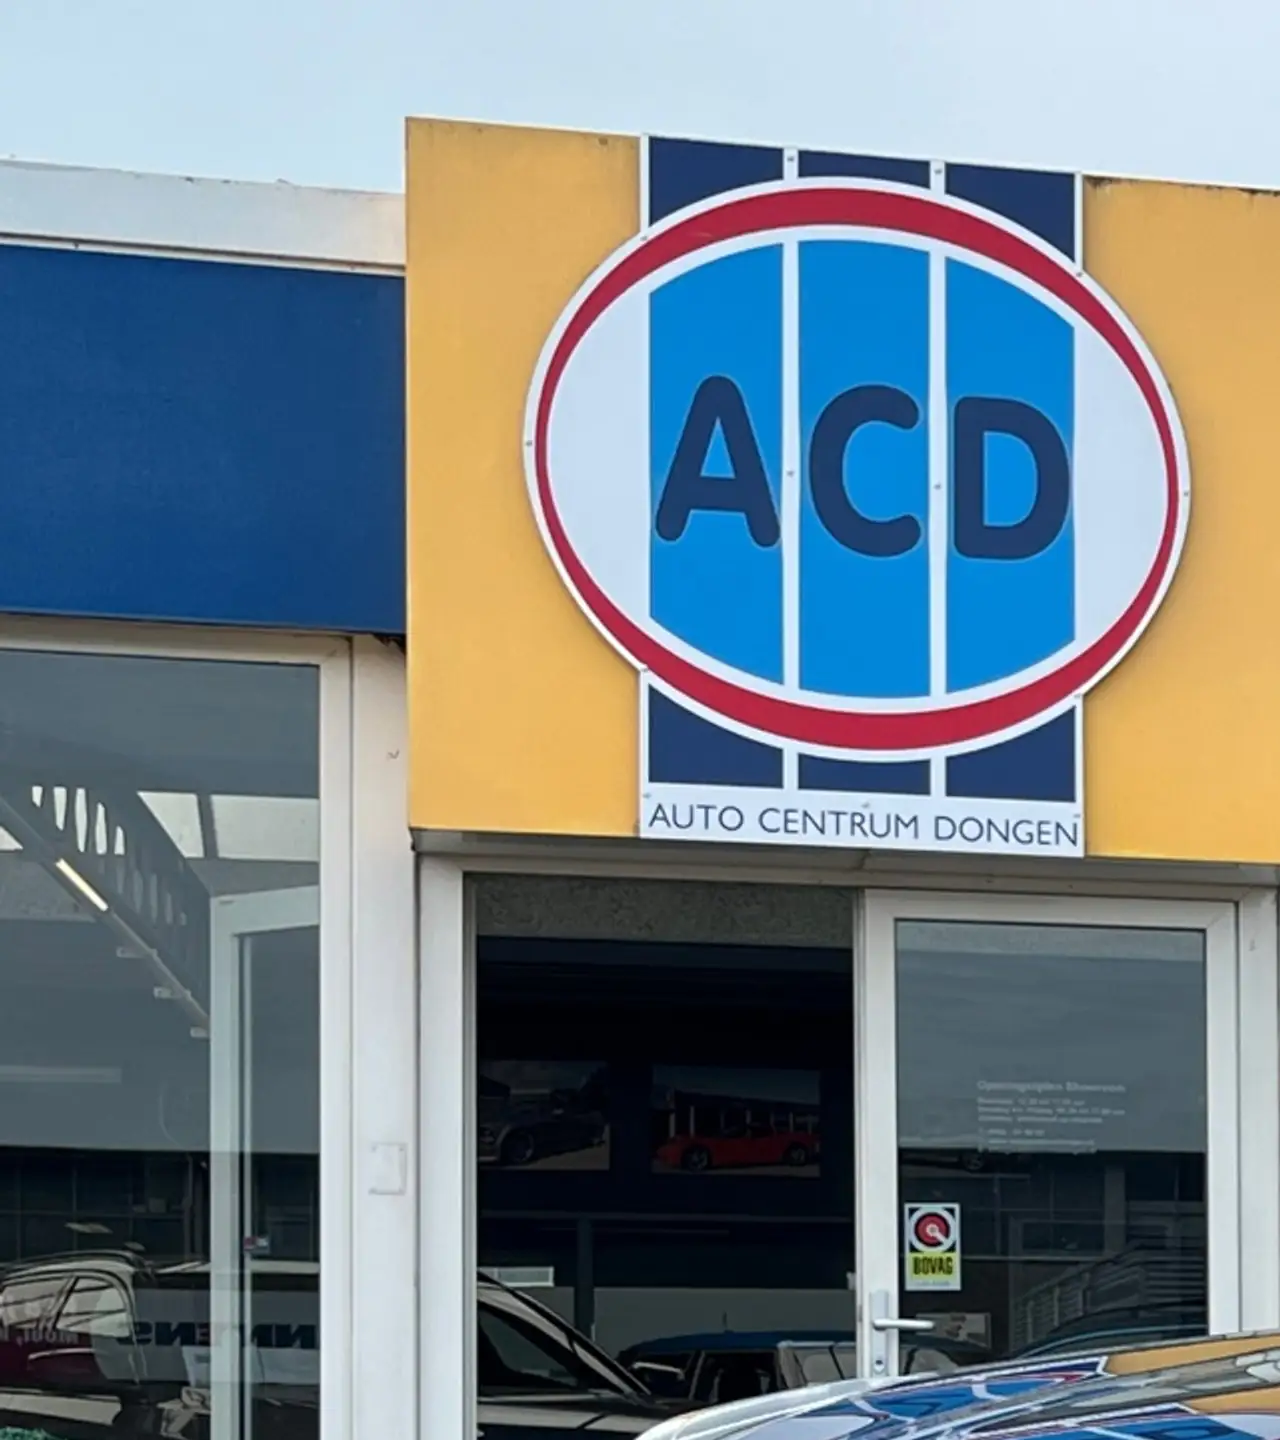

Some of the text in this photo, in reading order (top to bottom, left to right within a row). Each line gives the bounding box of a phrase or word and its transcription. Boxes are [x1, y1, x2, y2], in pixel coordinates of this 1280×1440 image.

[655, 374, 1072, 561] ACD
[648, 803, 1079, 847] AUTO CENTRUM DONGEN
[913, 1256, 953, 1275] BOVAG
